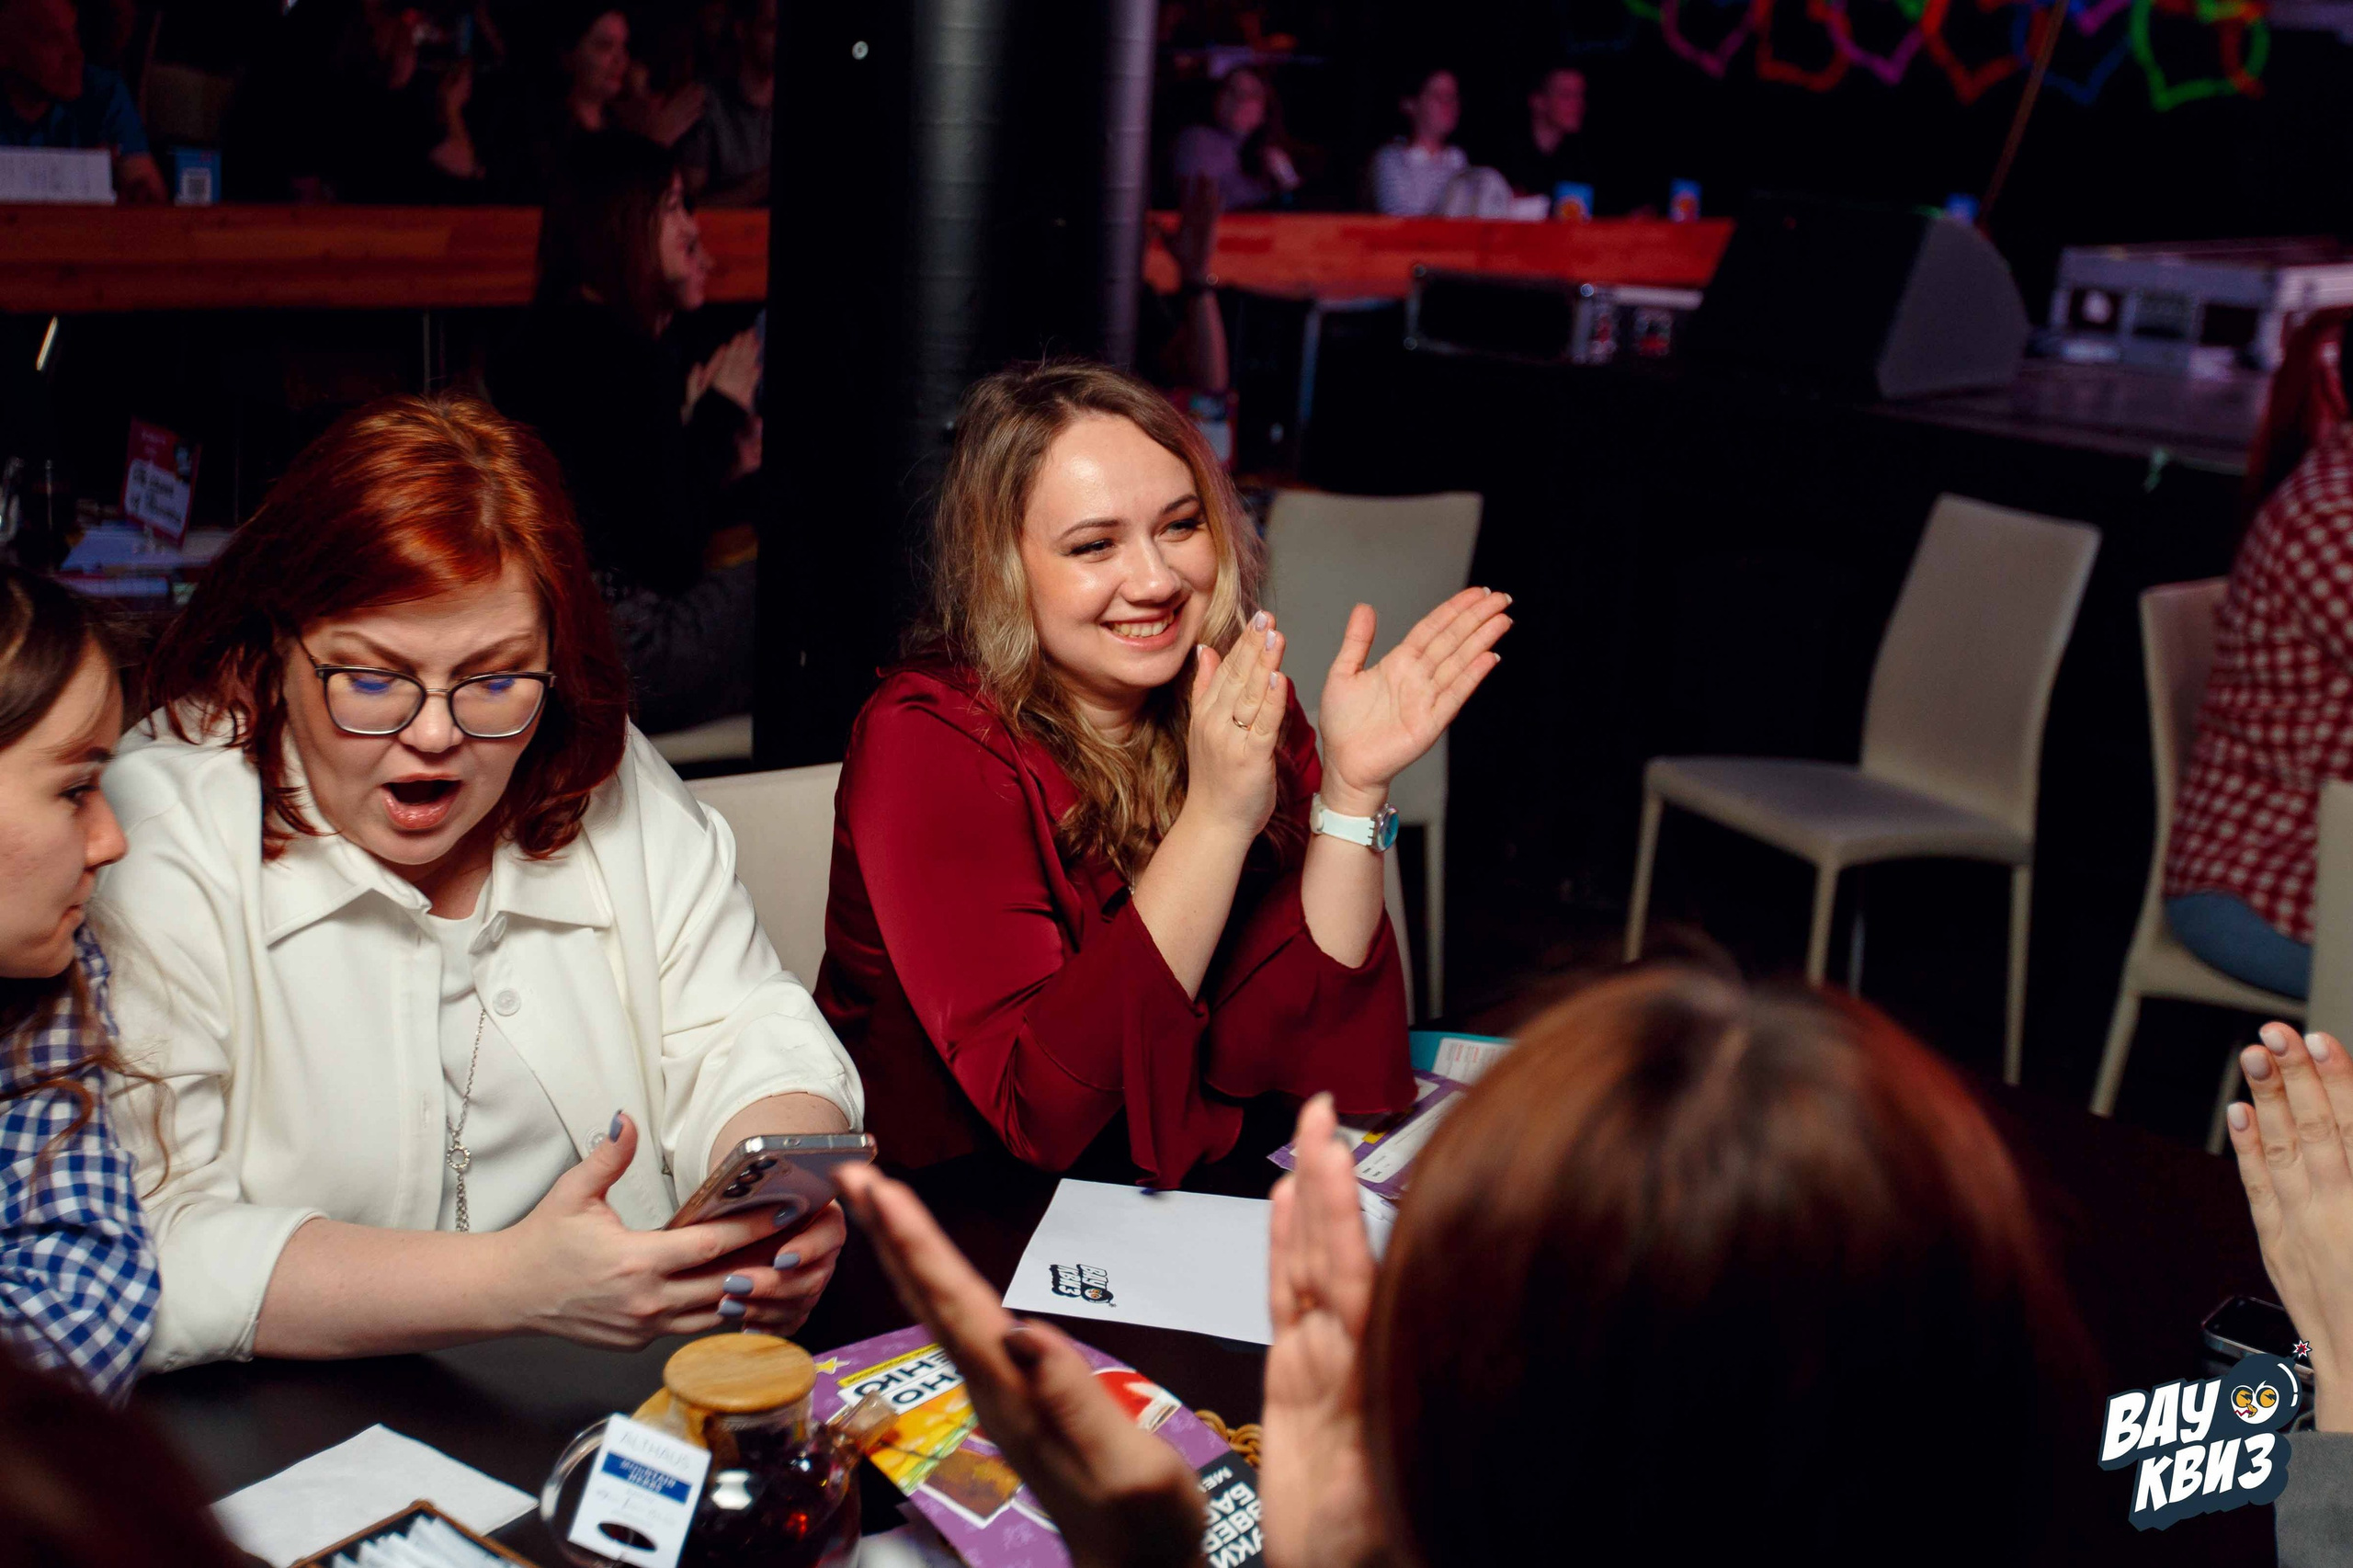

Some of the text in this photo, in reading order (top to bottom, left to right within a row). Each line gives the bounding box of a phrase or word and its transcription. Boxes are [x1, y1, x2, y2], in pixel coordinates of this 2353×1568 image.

[1057, 1265, 1082, 1297] КВИЗ
[1080, 1264, 1108, 1290] ВАУ
[855, 1349, 949, 1398] ЕНЮ
[892, 1369, 963, 1404] НО
[1199, 1466, 1234, 1492] МЕ
[1208, 1526, 1265, 1568] УКИ
